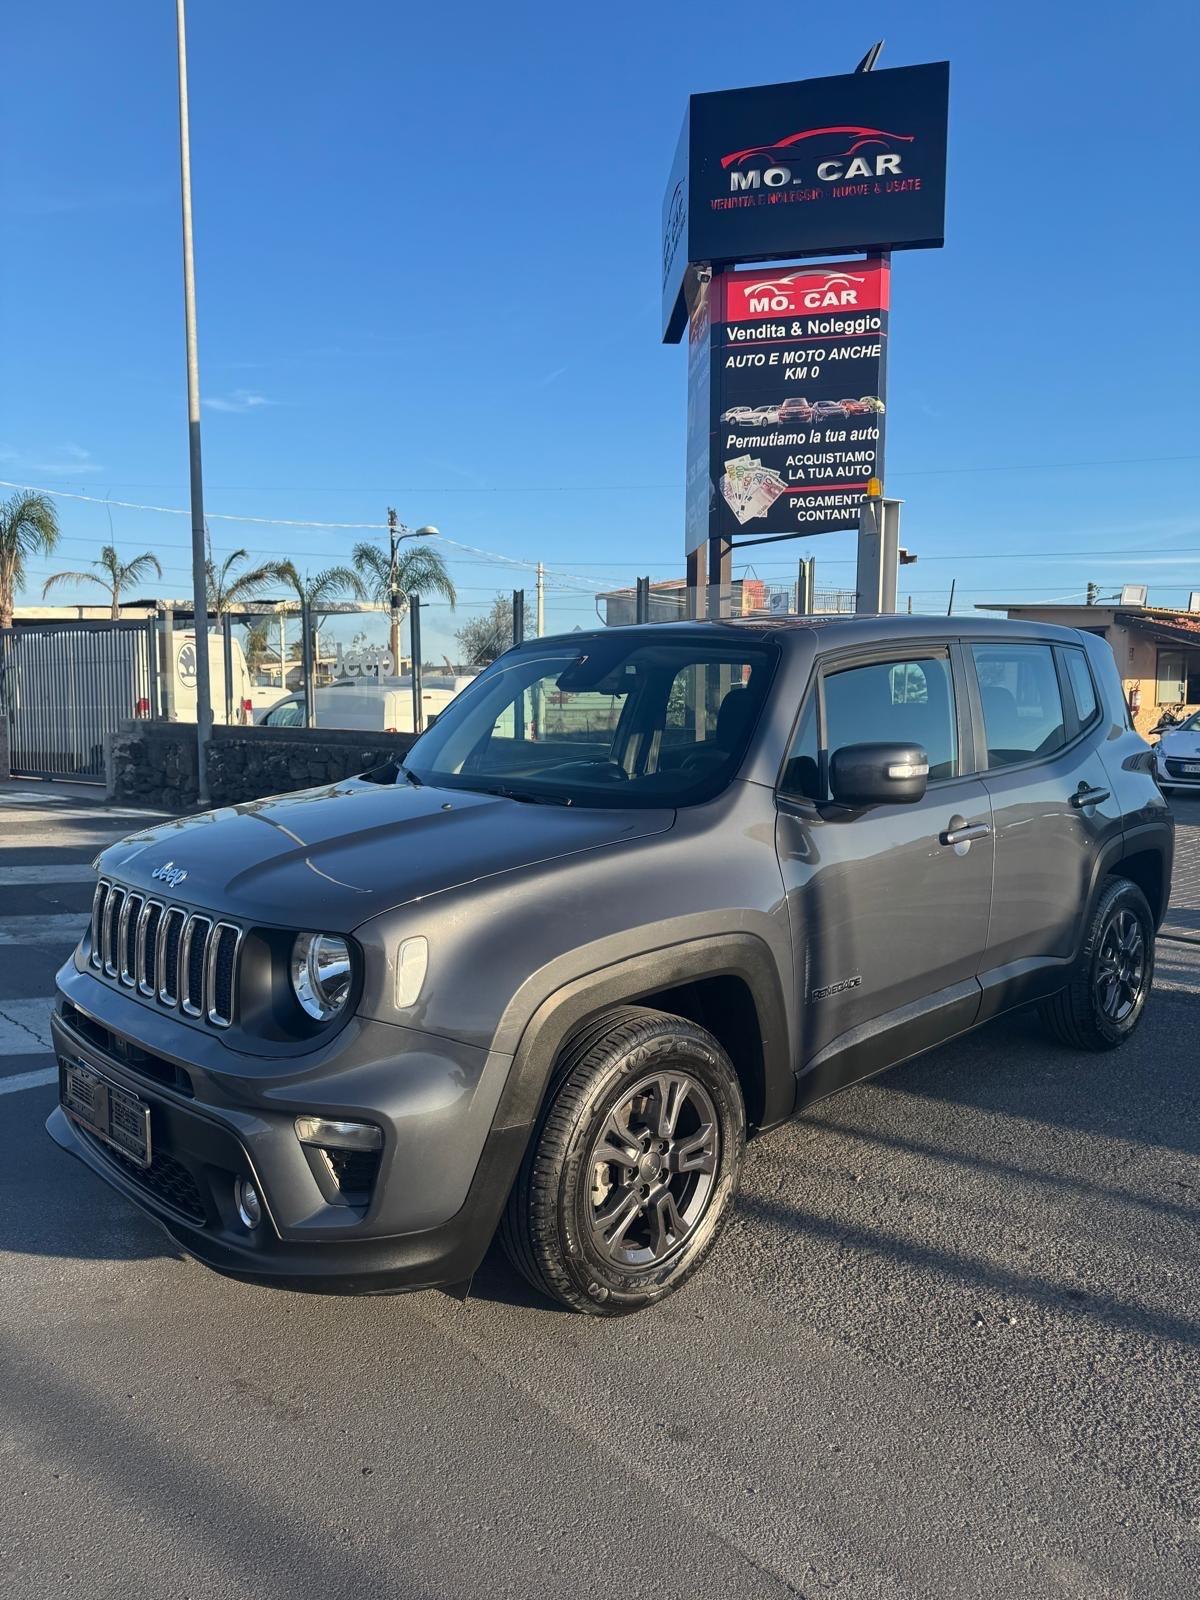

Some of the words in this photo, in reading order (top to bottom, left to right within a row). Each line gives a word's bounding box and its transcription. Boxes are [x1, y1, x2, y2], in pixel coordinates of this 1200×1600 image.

[730, 167, 801, 191] MO.
[817, 153, 903, 182] CAR
[711, 195, 755, 210] VENDITA
[767, 187, 823, 204] NOLEGGIO
[832, 183, 869, 198] NUOVE
[874, 181, 881, 194] &
[886, 178, 921, 193] USATE
[749, 297, 795, 313] MO.
[804, 290, 858, 308] CAR
[726, 323, 786, 341] Vendita
[790, 321, 803, 336] &
[808, 315, 882, 335] Noleggio
[725, 353, 766, 368] AUTO
[769, 352, 779, 365] E
[782, 349, 826, 364] MOTO
[828, 344, 882, 361] ANCHE
[784, 367, 807, 380] KM
[726, 432, 806, 449] Permutiamo
[809, 429, 821, 444] la
[825, 428, 847, 443] tua
[850, 426, 880, 441] auto
[786, 450, 875, 467] ACQUISTIAMO
[788, 468, 805, 480] LA
[808, 467, 834, 479] TUA
[836, 464, 872, 477] AUTO
[797, 507, 861, 522] CONTANTI
[328, 643, 395, 684] Jeep
[152, 862, 188, 888] Jeep
[812, 975, 862, 1002] RENEGADE
